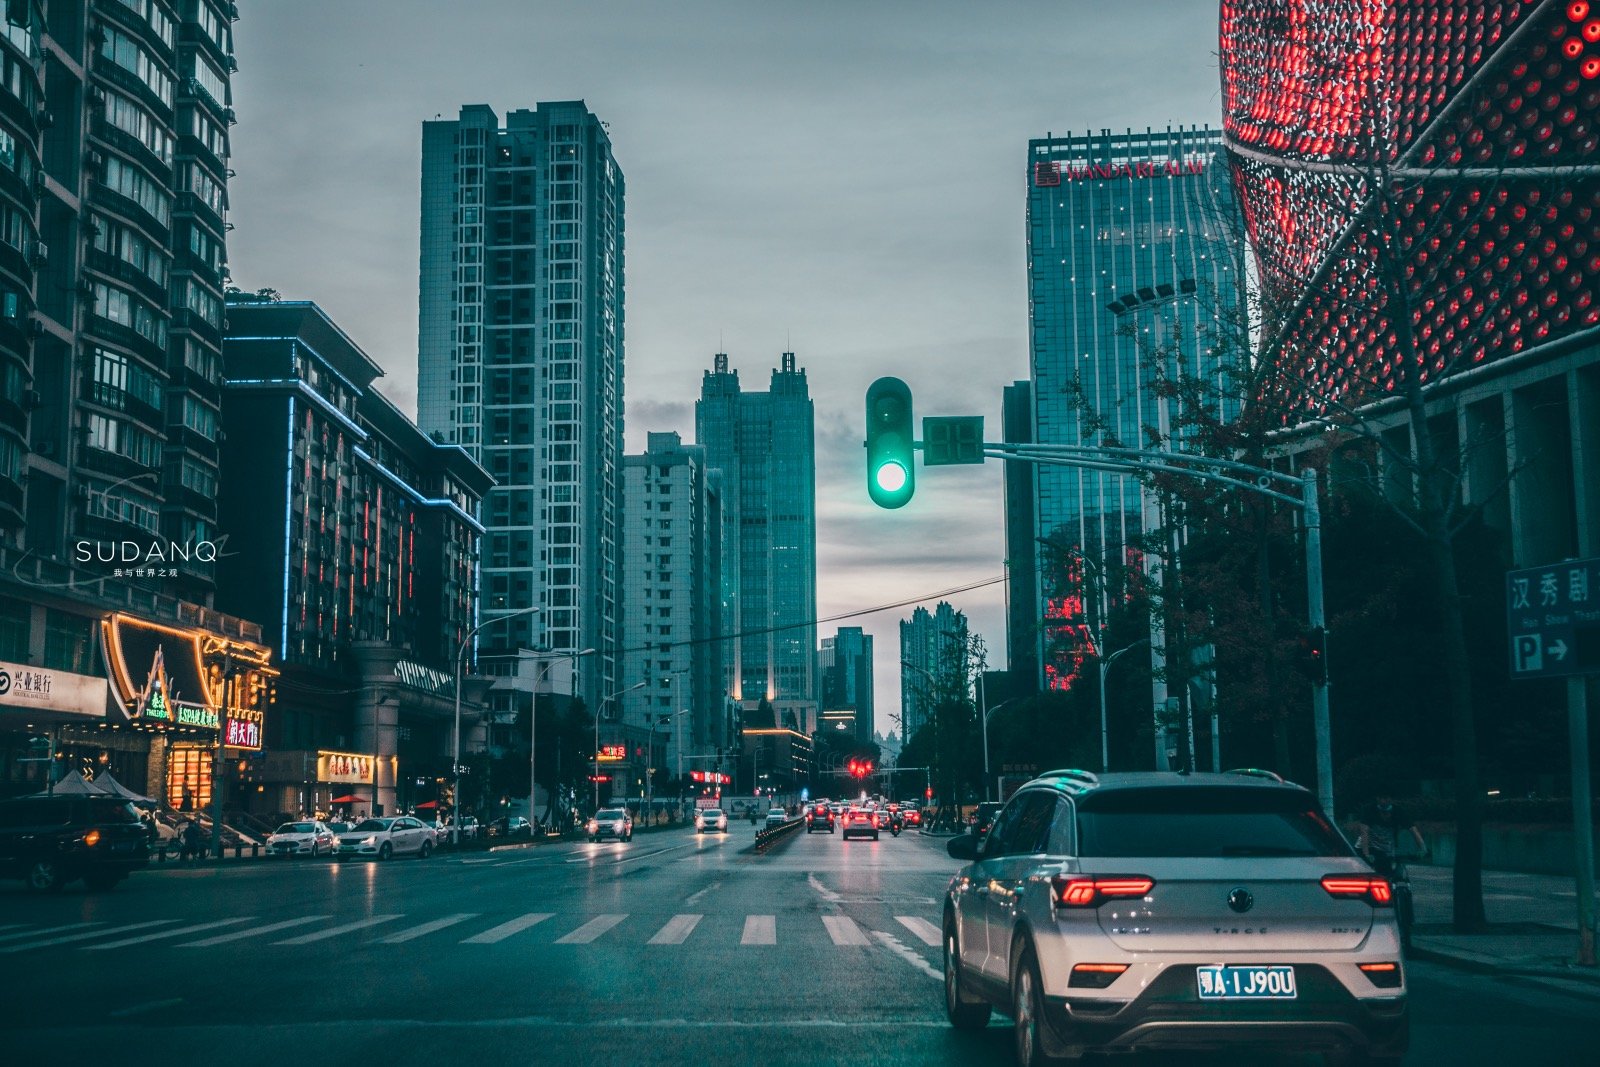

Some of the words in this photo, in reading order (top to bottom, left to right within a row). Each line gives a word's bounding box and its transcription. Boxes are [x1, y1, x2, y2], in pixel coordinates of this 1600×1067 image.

[1066, 162, 1133, 181] WANDA
[1136, 160, 1203, 177] REALM
[1513, 567, 1600, 609] 汉秀剧
[13, 670, 52, 694] 兴业银行
